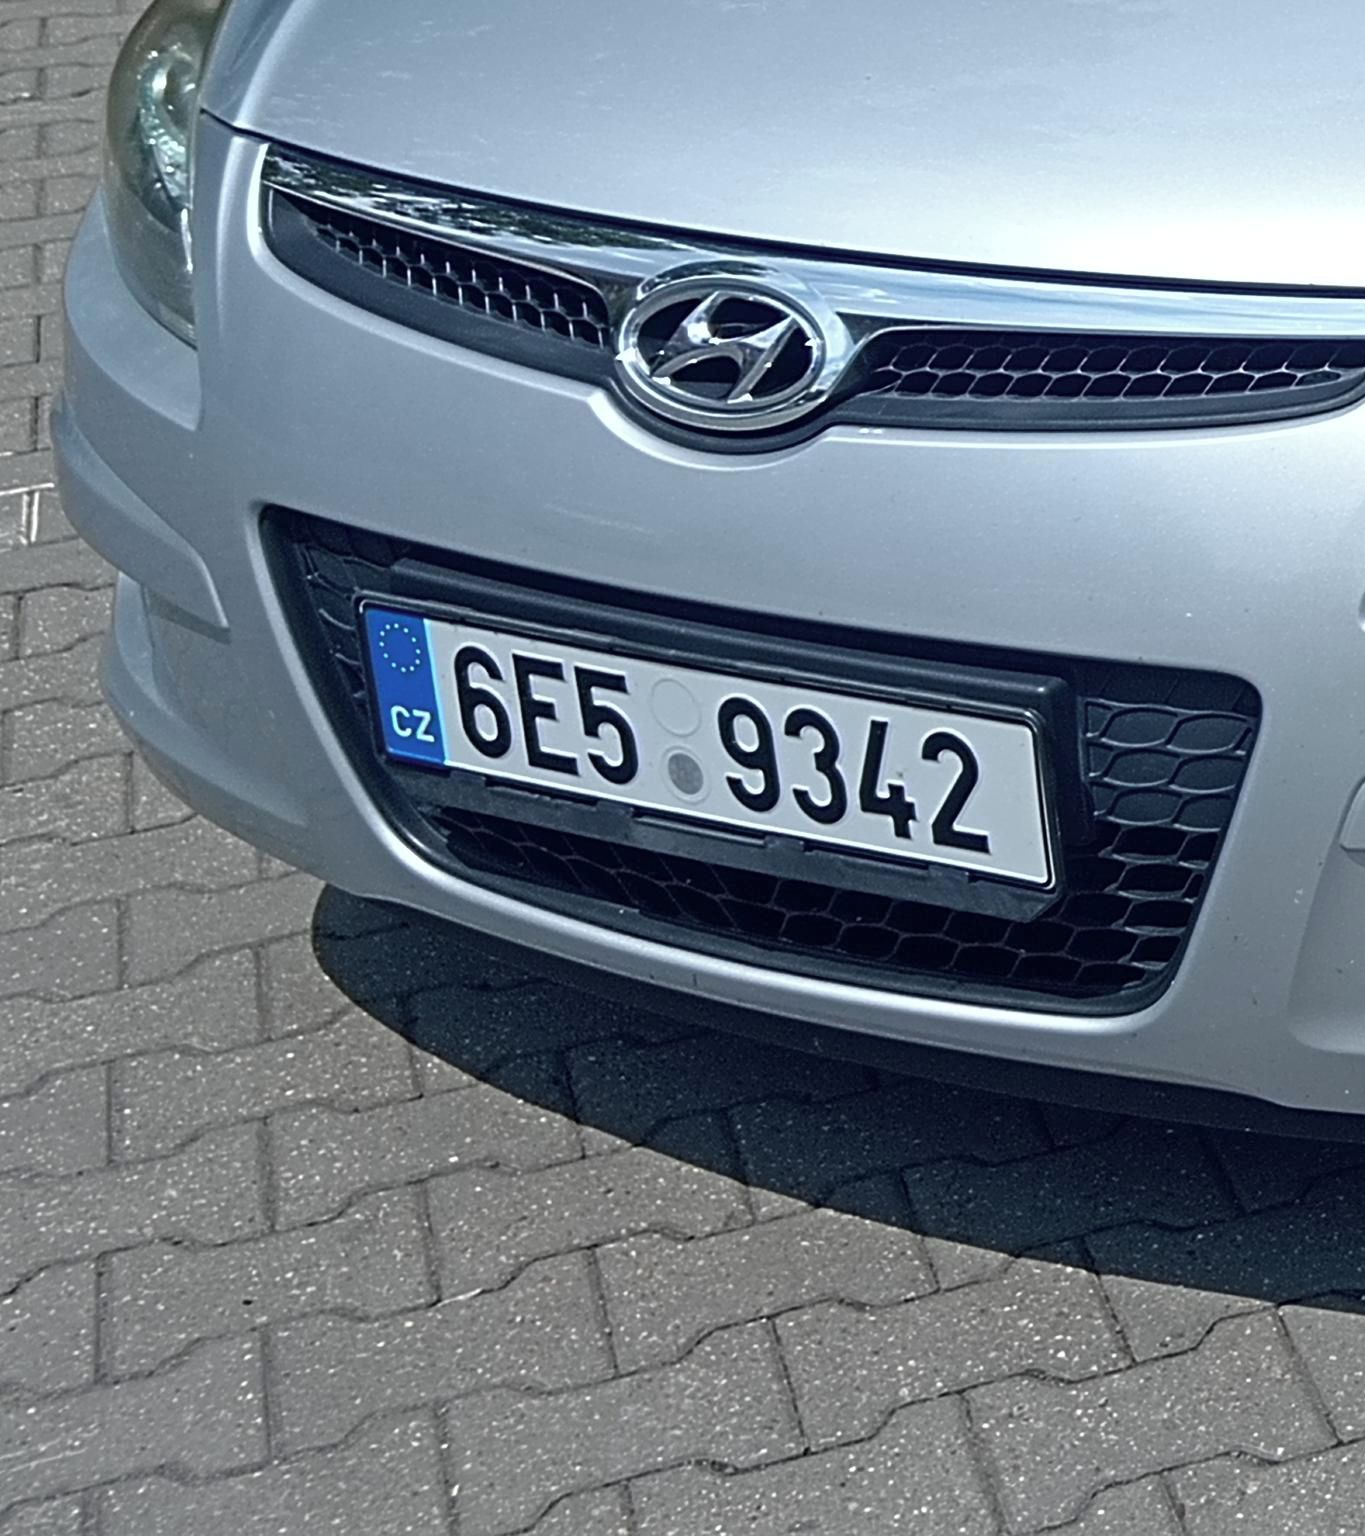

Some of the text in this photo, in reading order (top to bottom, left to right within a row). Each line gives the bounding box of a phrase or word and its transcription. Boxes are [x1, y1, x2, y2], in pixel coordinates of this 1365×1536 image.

[390, 705, 435, 742] CZ
[453, 645, 991, 854] 6E5 9342
